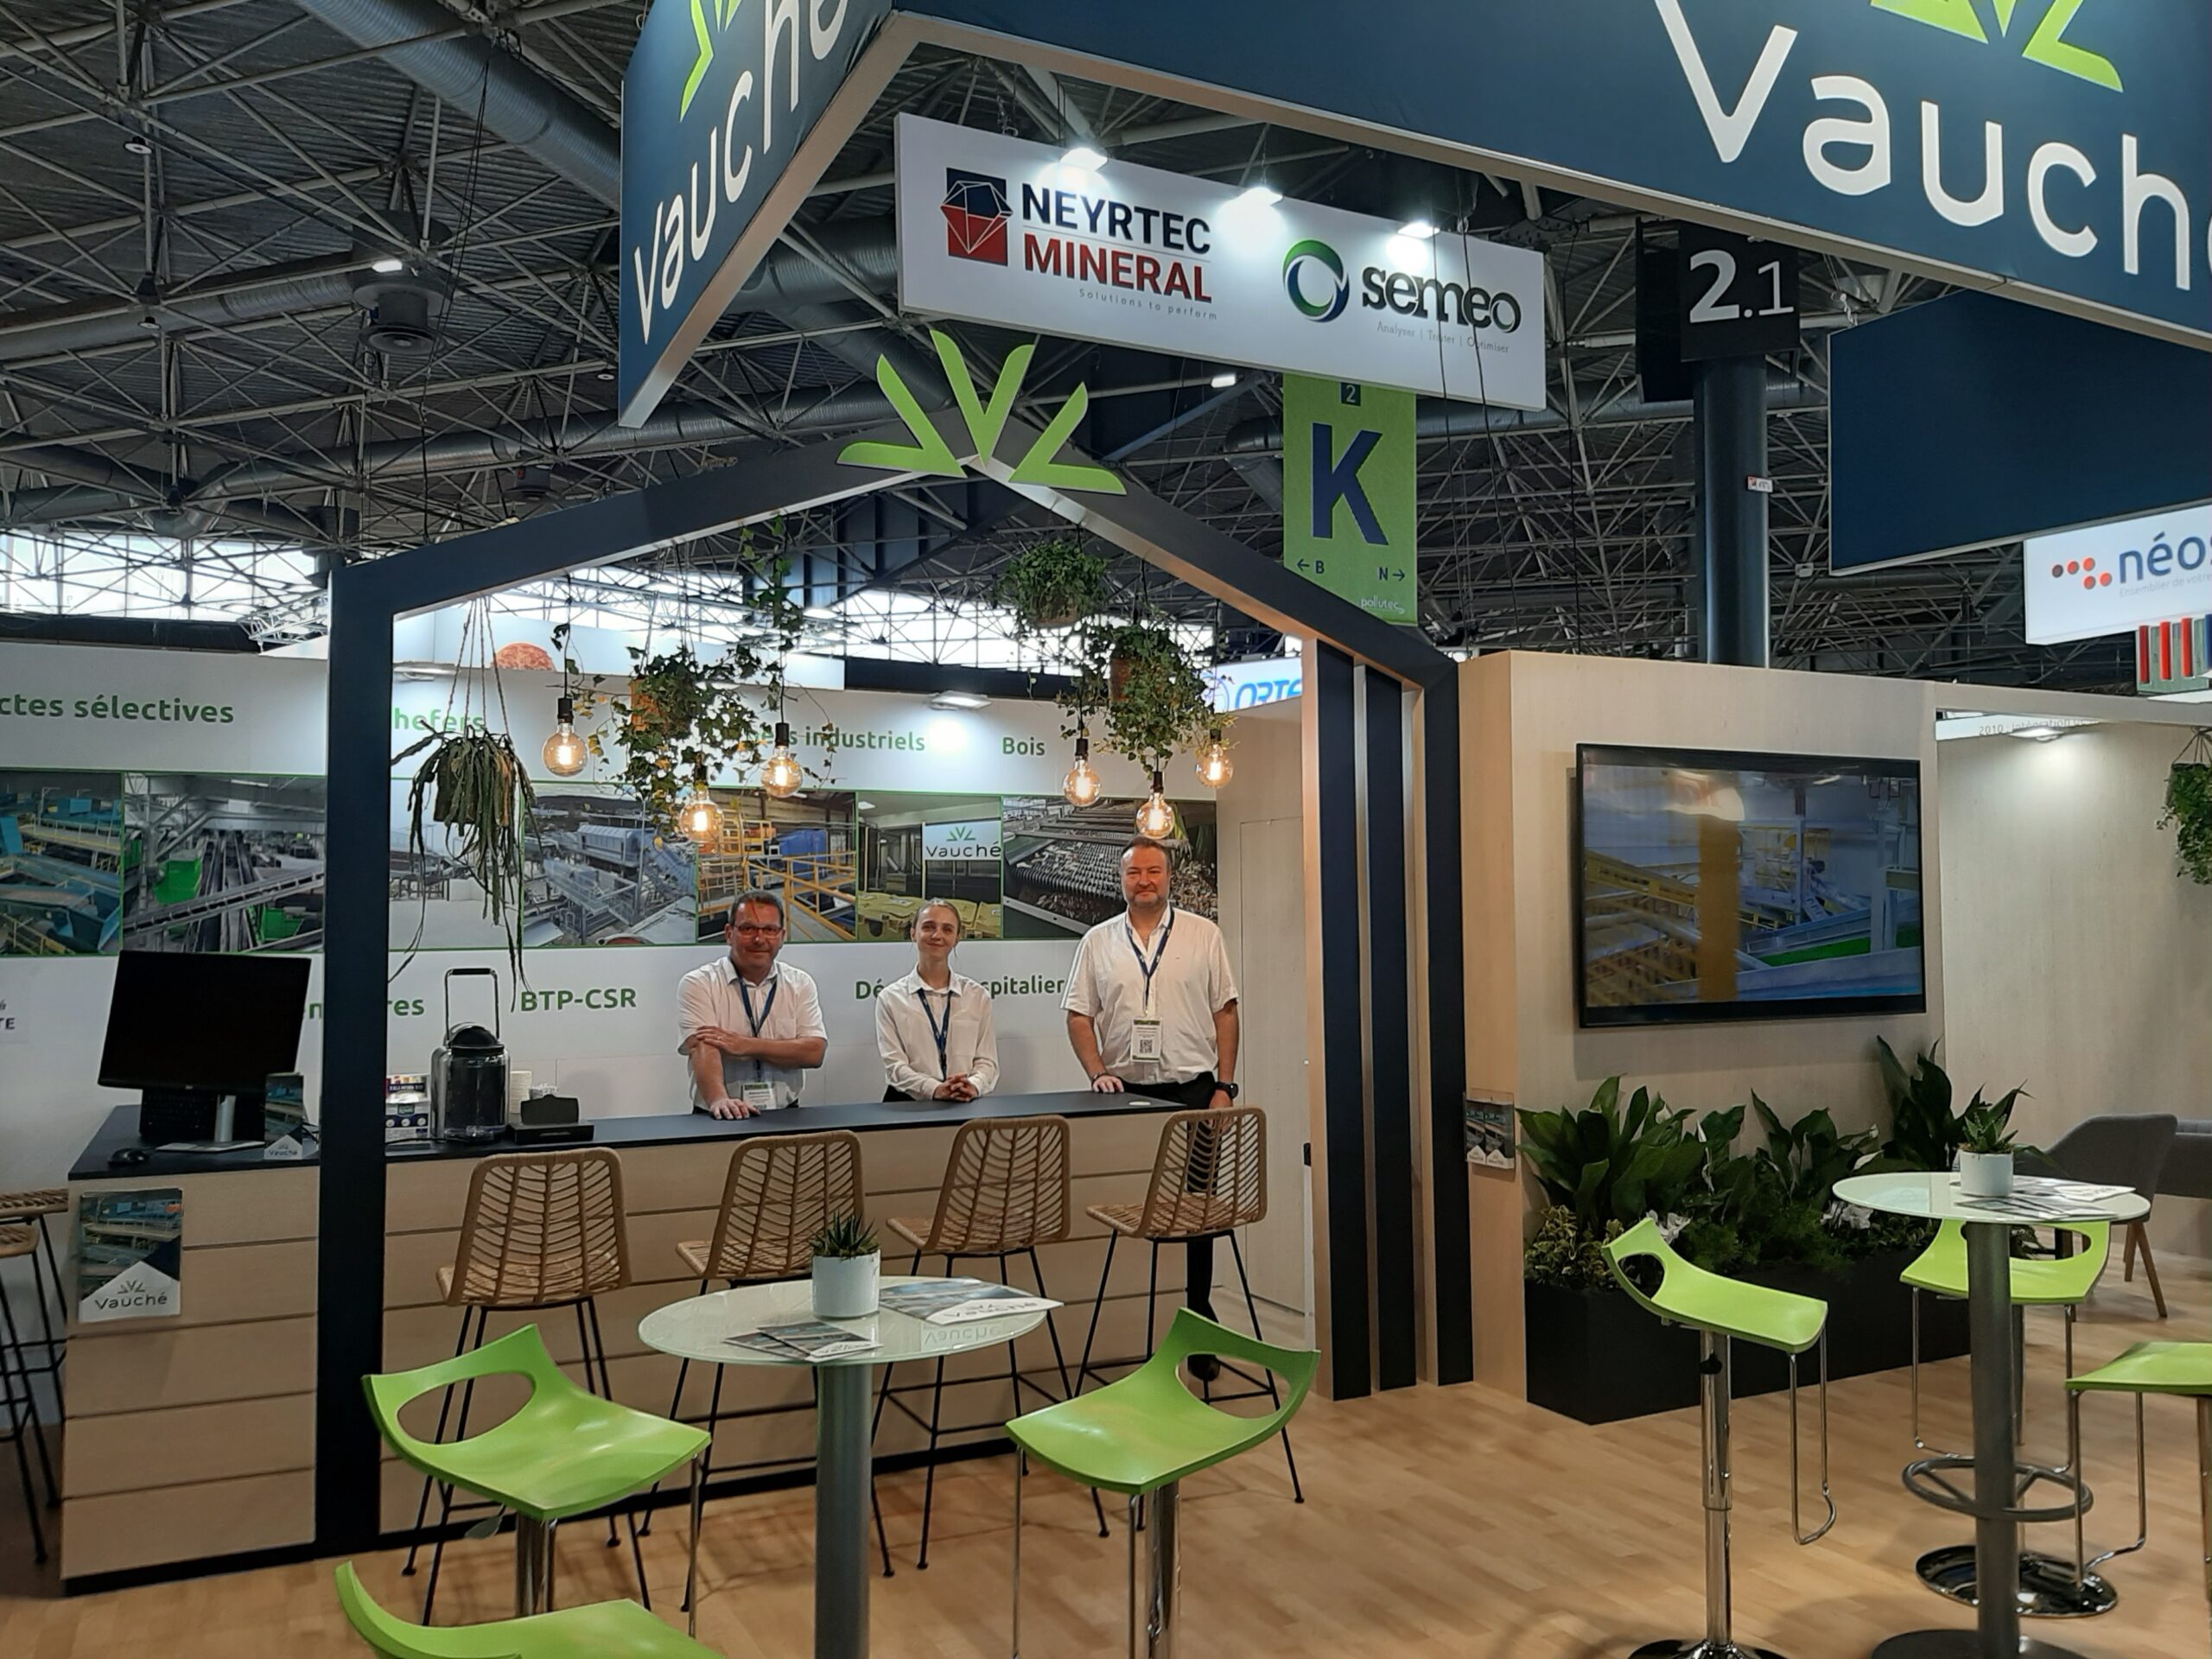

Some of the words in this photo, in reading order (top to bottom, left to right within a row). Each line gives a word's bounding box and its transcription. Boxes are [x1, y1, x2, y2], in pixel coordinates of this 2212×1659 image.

[1654, 0, 2212, 290] Vauch
[1021, 182, 1211, 255] NEYRTEC
[1024, 232, 1212, 303] MINERAL
[1362, 266, 1522, 334] semeo
[1688, 249, 1795, 324] 2.1
[1079, 288, 1141, 308] Solutions
[1149, 301, 1161, 311] to
[1168, 305, 1217, 321] perform
[1377, 321, 1415, 338] Analyser
[1345, 385, 1357, 404] 2
[1312, 422, 1389, 546] K
[1315, 560, 1325, 575] B
[2119, 531, 2212, 583] néo
[1378, 566, 1389, 582] N
[74, 694, 234, 724] sélectives
[1001, 736, 1046, 757] Bois
[926, 841, 1001, 858] Vauché
[520, 988, 637, 1012] BTP-CSR
[94, 1292, 168, 1310] Vauché
